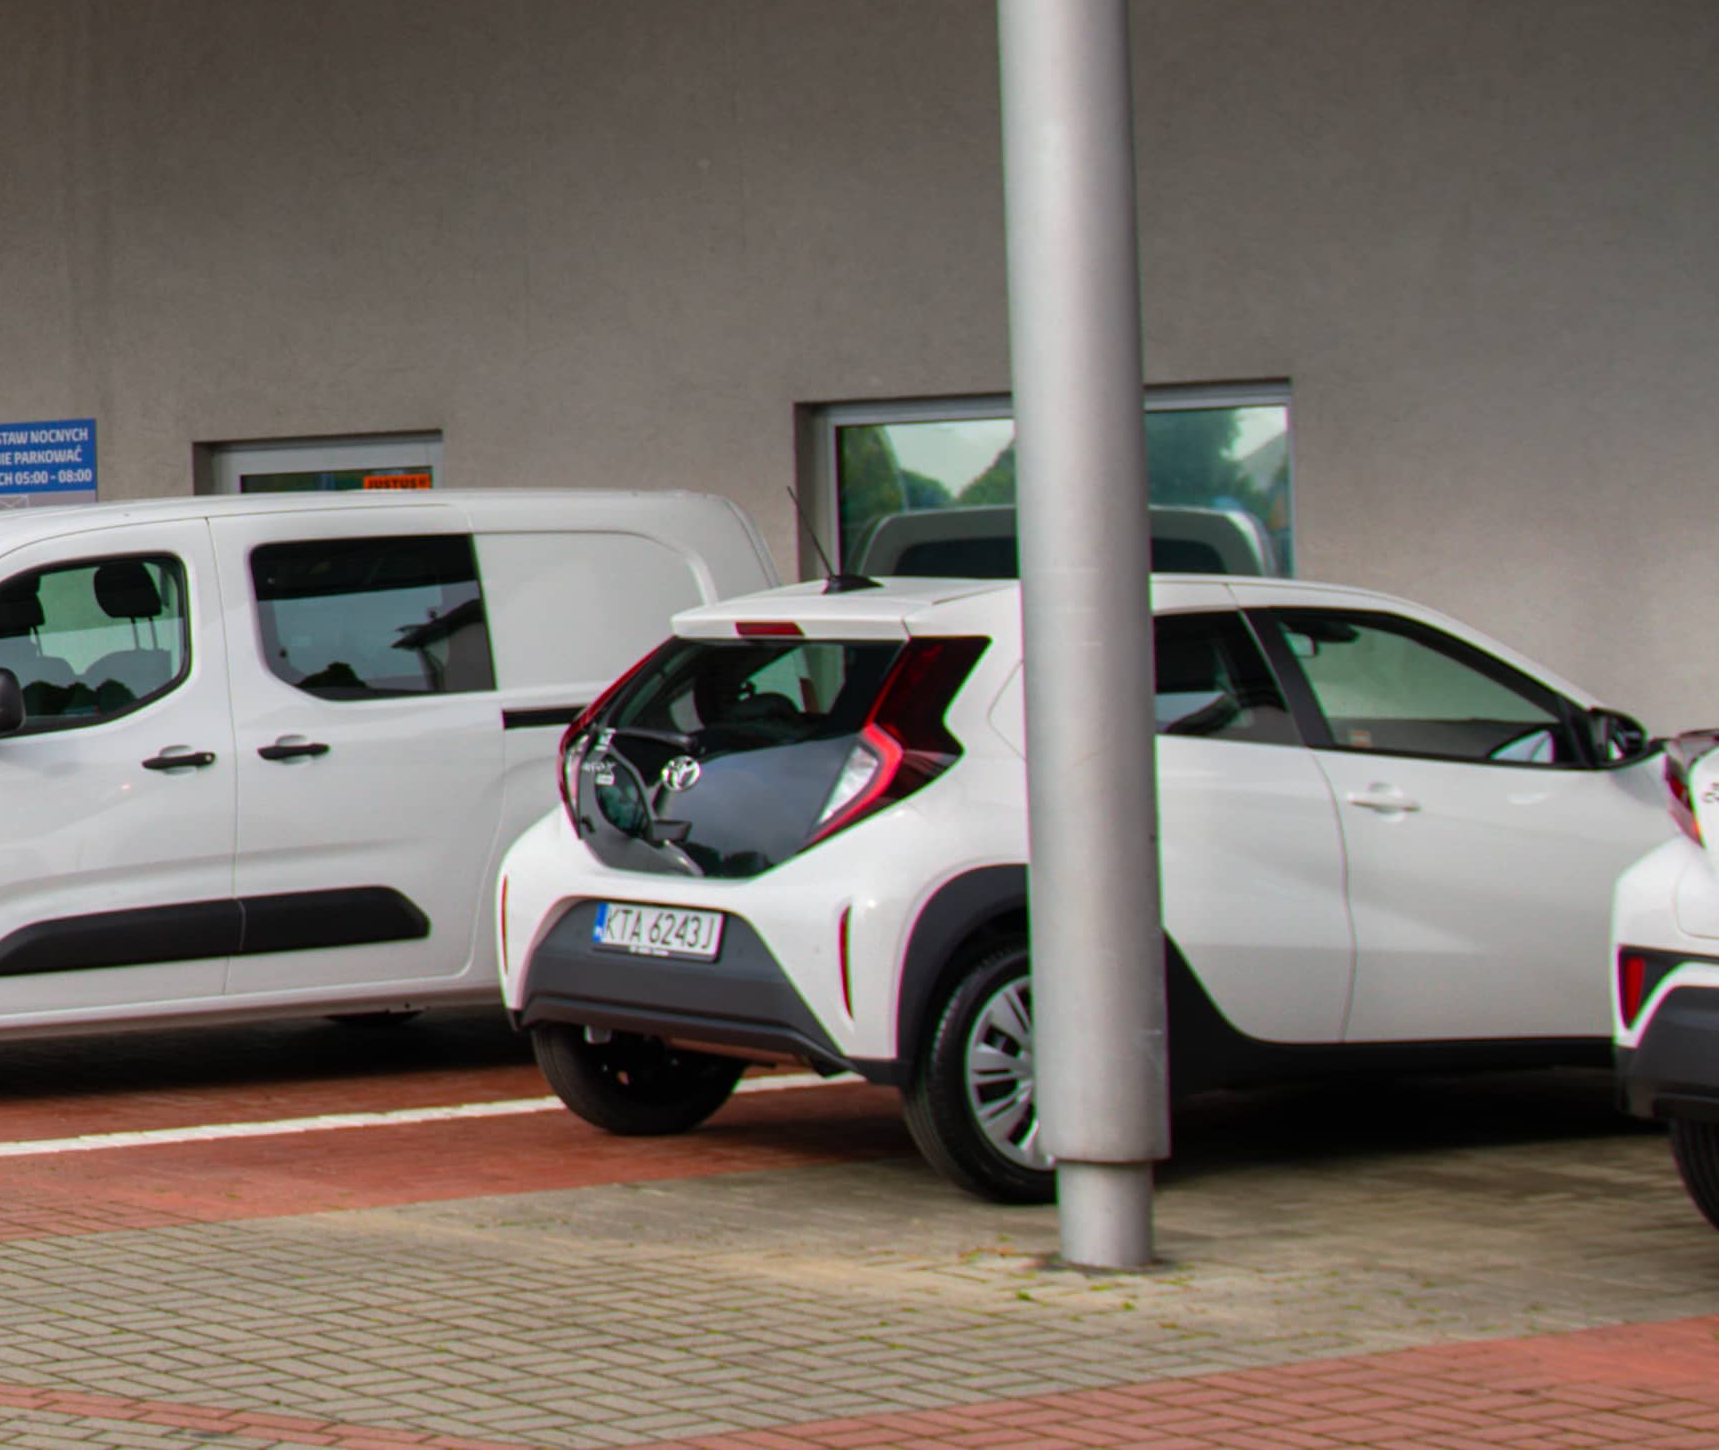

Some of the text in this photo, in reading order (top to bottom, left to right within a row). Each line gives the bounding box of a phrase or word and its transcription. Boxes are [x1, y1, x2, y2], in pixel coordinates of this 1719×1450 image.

[30, 427, 89, 444] NOCNYCH
[14, 445, 83, 465] PARKOWAĆ
[15, 470, 48, 486] 05:00
[58, 469, 93, 484] 08:00
[605, 906, 715, 949] KTA 6243J
